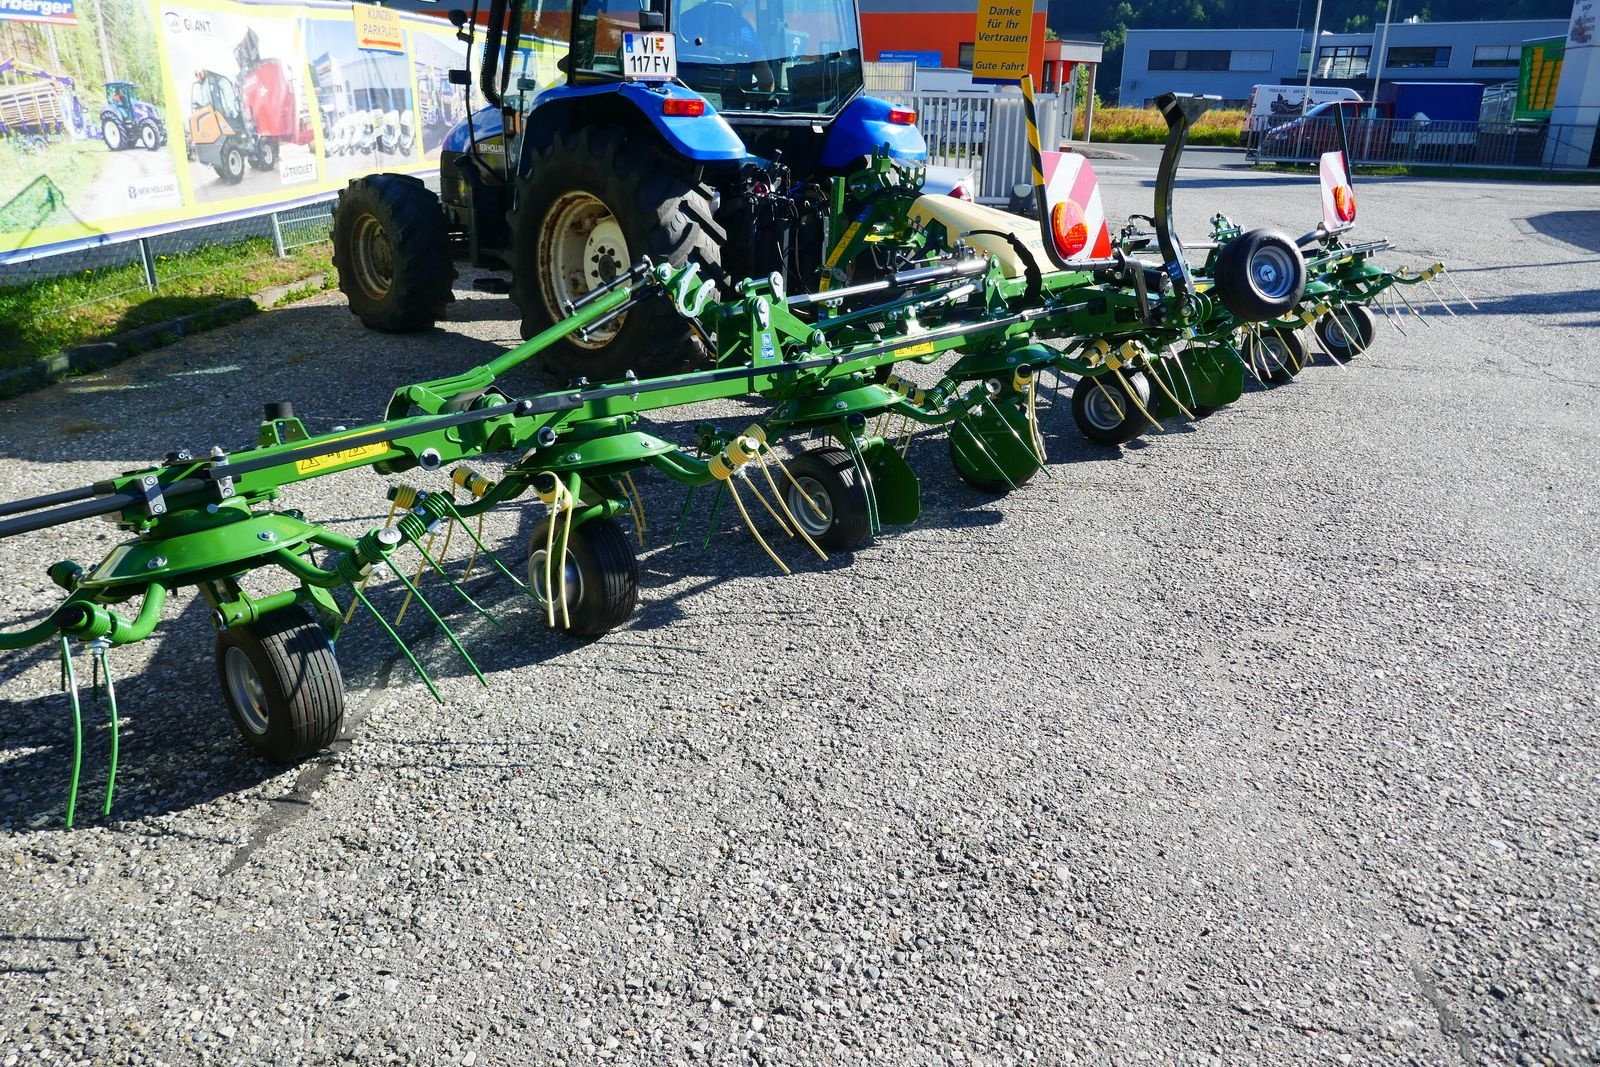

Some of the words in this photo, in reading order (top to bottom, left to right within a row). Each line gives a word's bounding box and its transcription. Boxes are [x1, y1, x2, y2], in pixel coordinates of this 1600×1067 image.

[989, 6, 1022, 16] Danke
[184, 18, 212, 32] GIANT
[987, 18, 1003, 29] für
[1005, 19, 1020, 29] Ihr
[978, 32, 1028, 42] Vertrauen
[641, 36, 654, 55] VI
[630, 55, 651, 73] 117
[654, 56, 670, 73] FV
[975, 60, 998, 70] Gute
[1000, 61, 1025, 71] Fahrt
